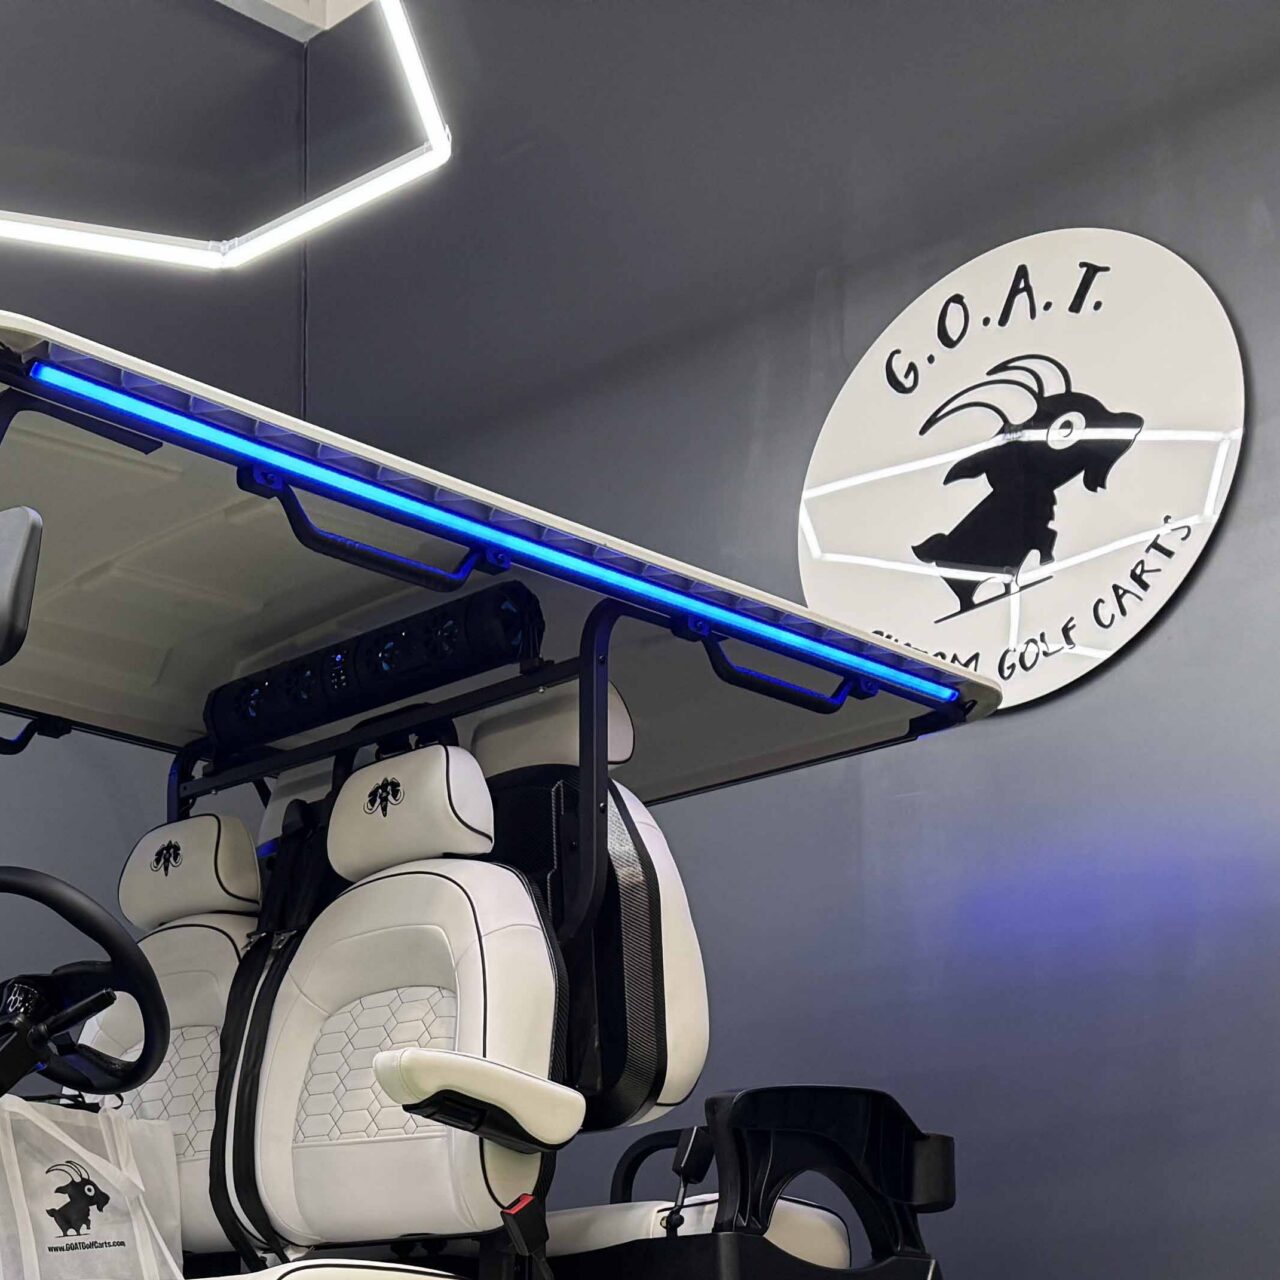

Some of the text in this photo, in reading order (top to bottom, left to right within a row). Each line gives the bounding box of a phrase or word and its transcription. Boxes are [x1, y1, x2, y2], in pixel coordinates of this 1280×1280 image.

[885, 261, 1111, 395] G.O.A.T.
[997, 616, 1076, 681] GOLF
[1093, 514, 1191, 629] CARTS
[47, 1240, 126, 1252] www.GOATGolfCarts.com
